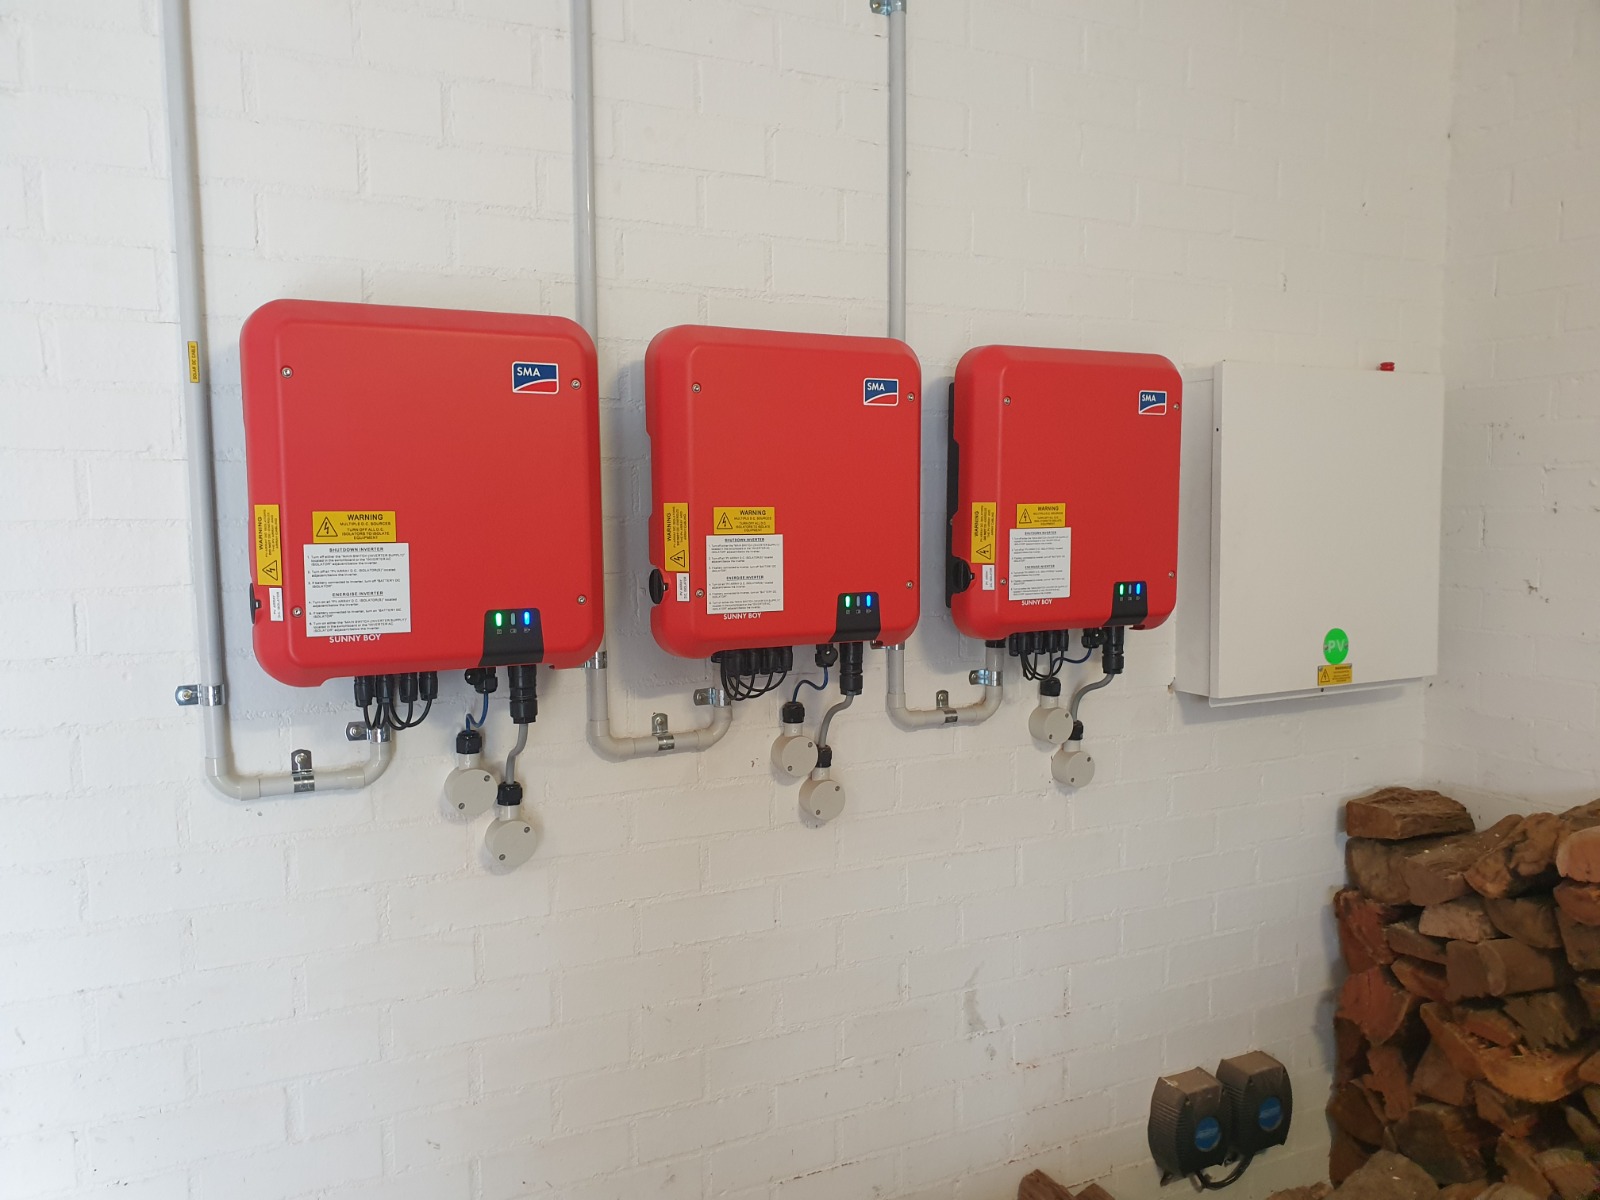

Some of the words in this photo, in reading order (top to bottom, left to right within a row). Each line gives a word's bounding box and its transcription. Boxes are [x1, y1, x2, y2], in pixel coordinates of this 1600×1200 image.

[516, 366, 541, 377] SMA
[867, 382, 886, 391] SMA
[1141, 394, 1156, 402] SMA
[329, 635, 362, 643] SUNNY
[1328, 639, 1345, 653] PV
